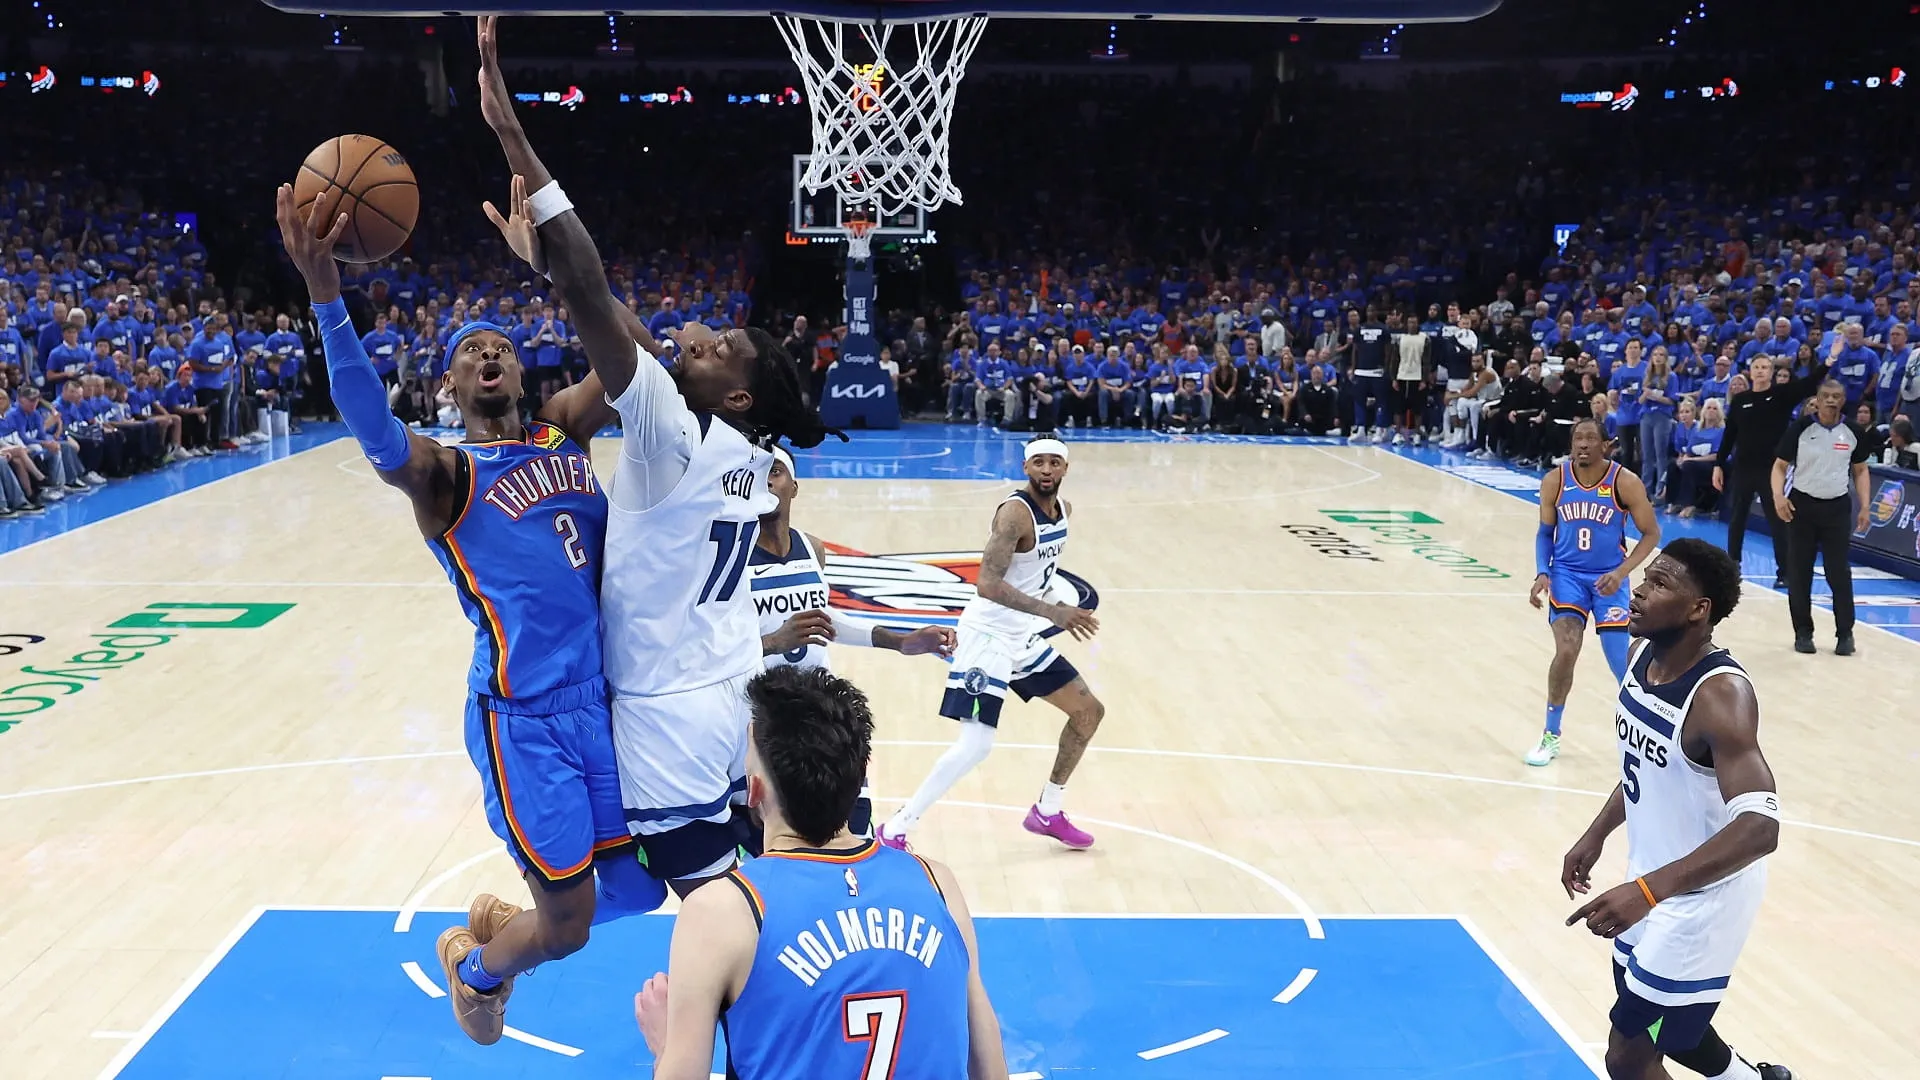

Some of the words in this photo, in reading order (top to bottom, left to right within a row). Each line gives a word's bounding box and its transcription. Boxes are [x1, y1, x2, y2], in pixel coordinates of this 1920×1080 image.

[1560, 91, 1613, 104] impactMD
[843, 353, 875, 365] Google
[831, 384, 886, 398] KIA
[483, 453, 597, 521] THUNDER
[722, 468, 755, 501] REID
[1558, 501, 1615, 525] THUNDER
[553, 511, 588, 570] 2
[1280, 524, 1385, 563] center
[1347, 525, 1512, 579] paycom
[1578, 527, 1591, 551] 8
[696, 519, 760, 607] 11
[753, 590, 827, 616] WOLVES
[1623, 750, 1641, 805] 5
[1764, 797, 1778, 811] 5
[777, 907, 944, 987] HOLMGREN
[842, 989, 908, 1080] 7
